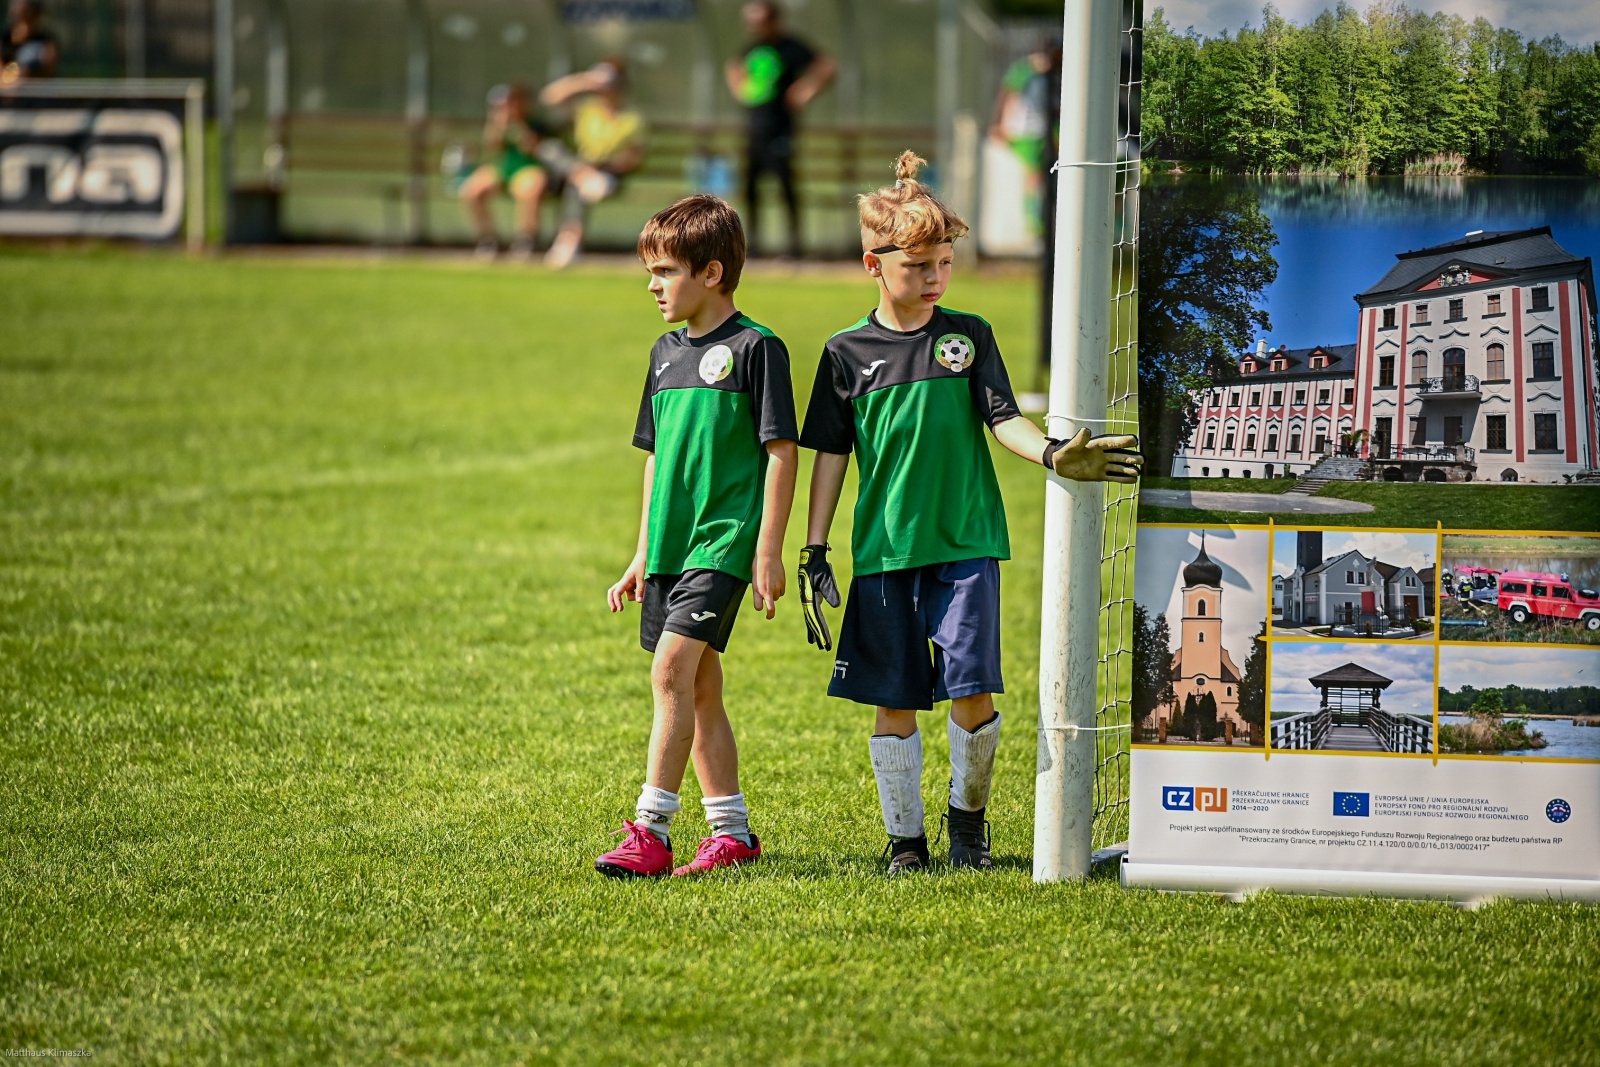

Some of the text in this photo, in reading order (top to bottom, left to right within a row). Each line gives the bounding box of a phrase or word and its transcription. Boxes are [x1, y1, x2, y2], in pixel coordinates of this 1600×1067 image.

[1232, 789, 1280, 798] PŘEKRAČUJEME
[1374, 794, 1407, 802] EVROPSKÁ
[1443, 803, 1482, 812] REGIONÁLNÍ
[1374, 809, 1412, 817] EUROPEJSKI
[1479, 813, 1529, 821] REGIONALNEGO
[1169, 824, 1193, 833] Projekt
[1208, 825, 1271, 835] współfinansowany
[1281, 827, 1310, 835] środków
[1312, 828, 1360, 838] Europejskiego
[1395, 832, 1425, 840] Rozwoju
[1426, 833, 1474, 842] Regionalnego
[1491, 835, 1520, 843] budżetu
[1290, 837, 1318, 845] Granice,
[1327, 838, 1356, 847] projektu
